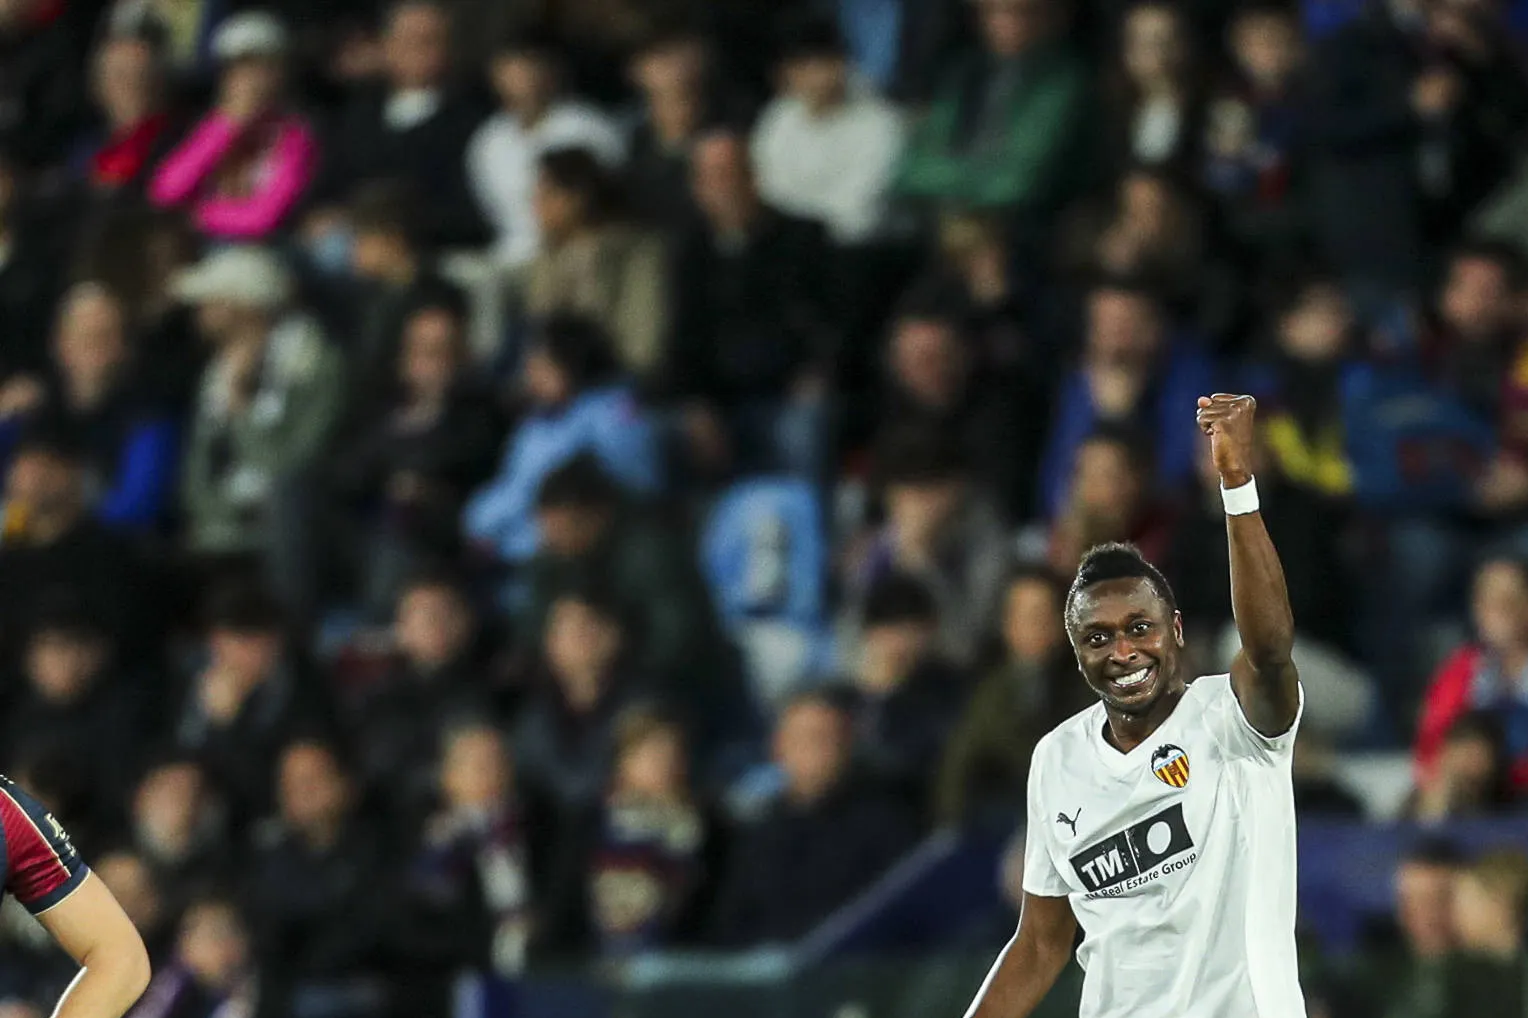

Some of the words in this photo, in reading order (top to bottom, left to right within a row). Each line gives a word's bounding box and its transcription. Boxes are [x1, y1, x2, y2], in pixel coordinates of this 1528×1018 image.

[1081, 846, 1125, 887] TM
[1101, 882, 1124, 897] Real
[1126, 870, 1159, 890] Estate
[1161, 852, 1197, 875] Group
